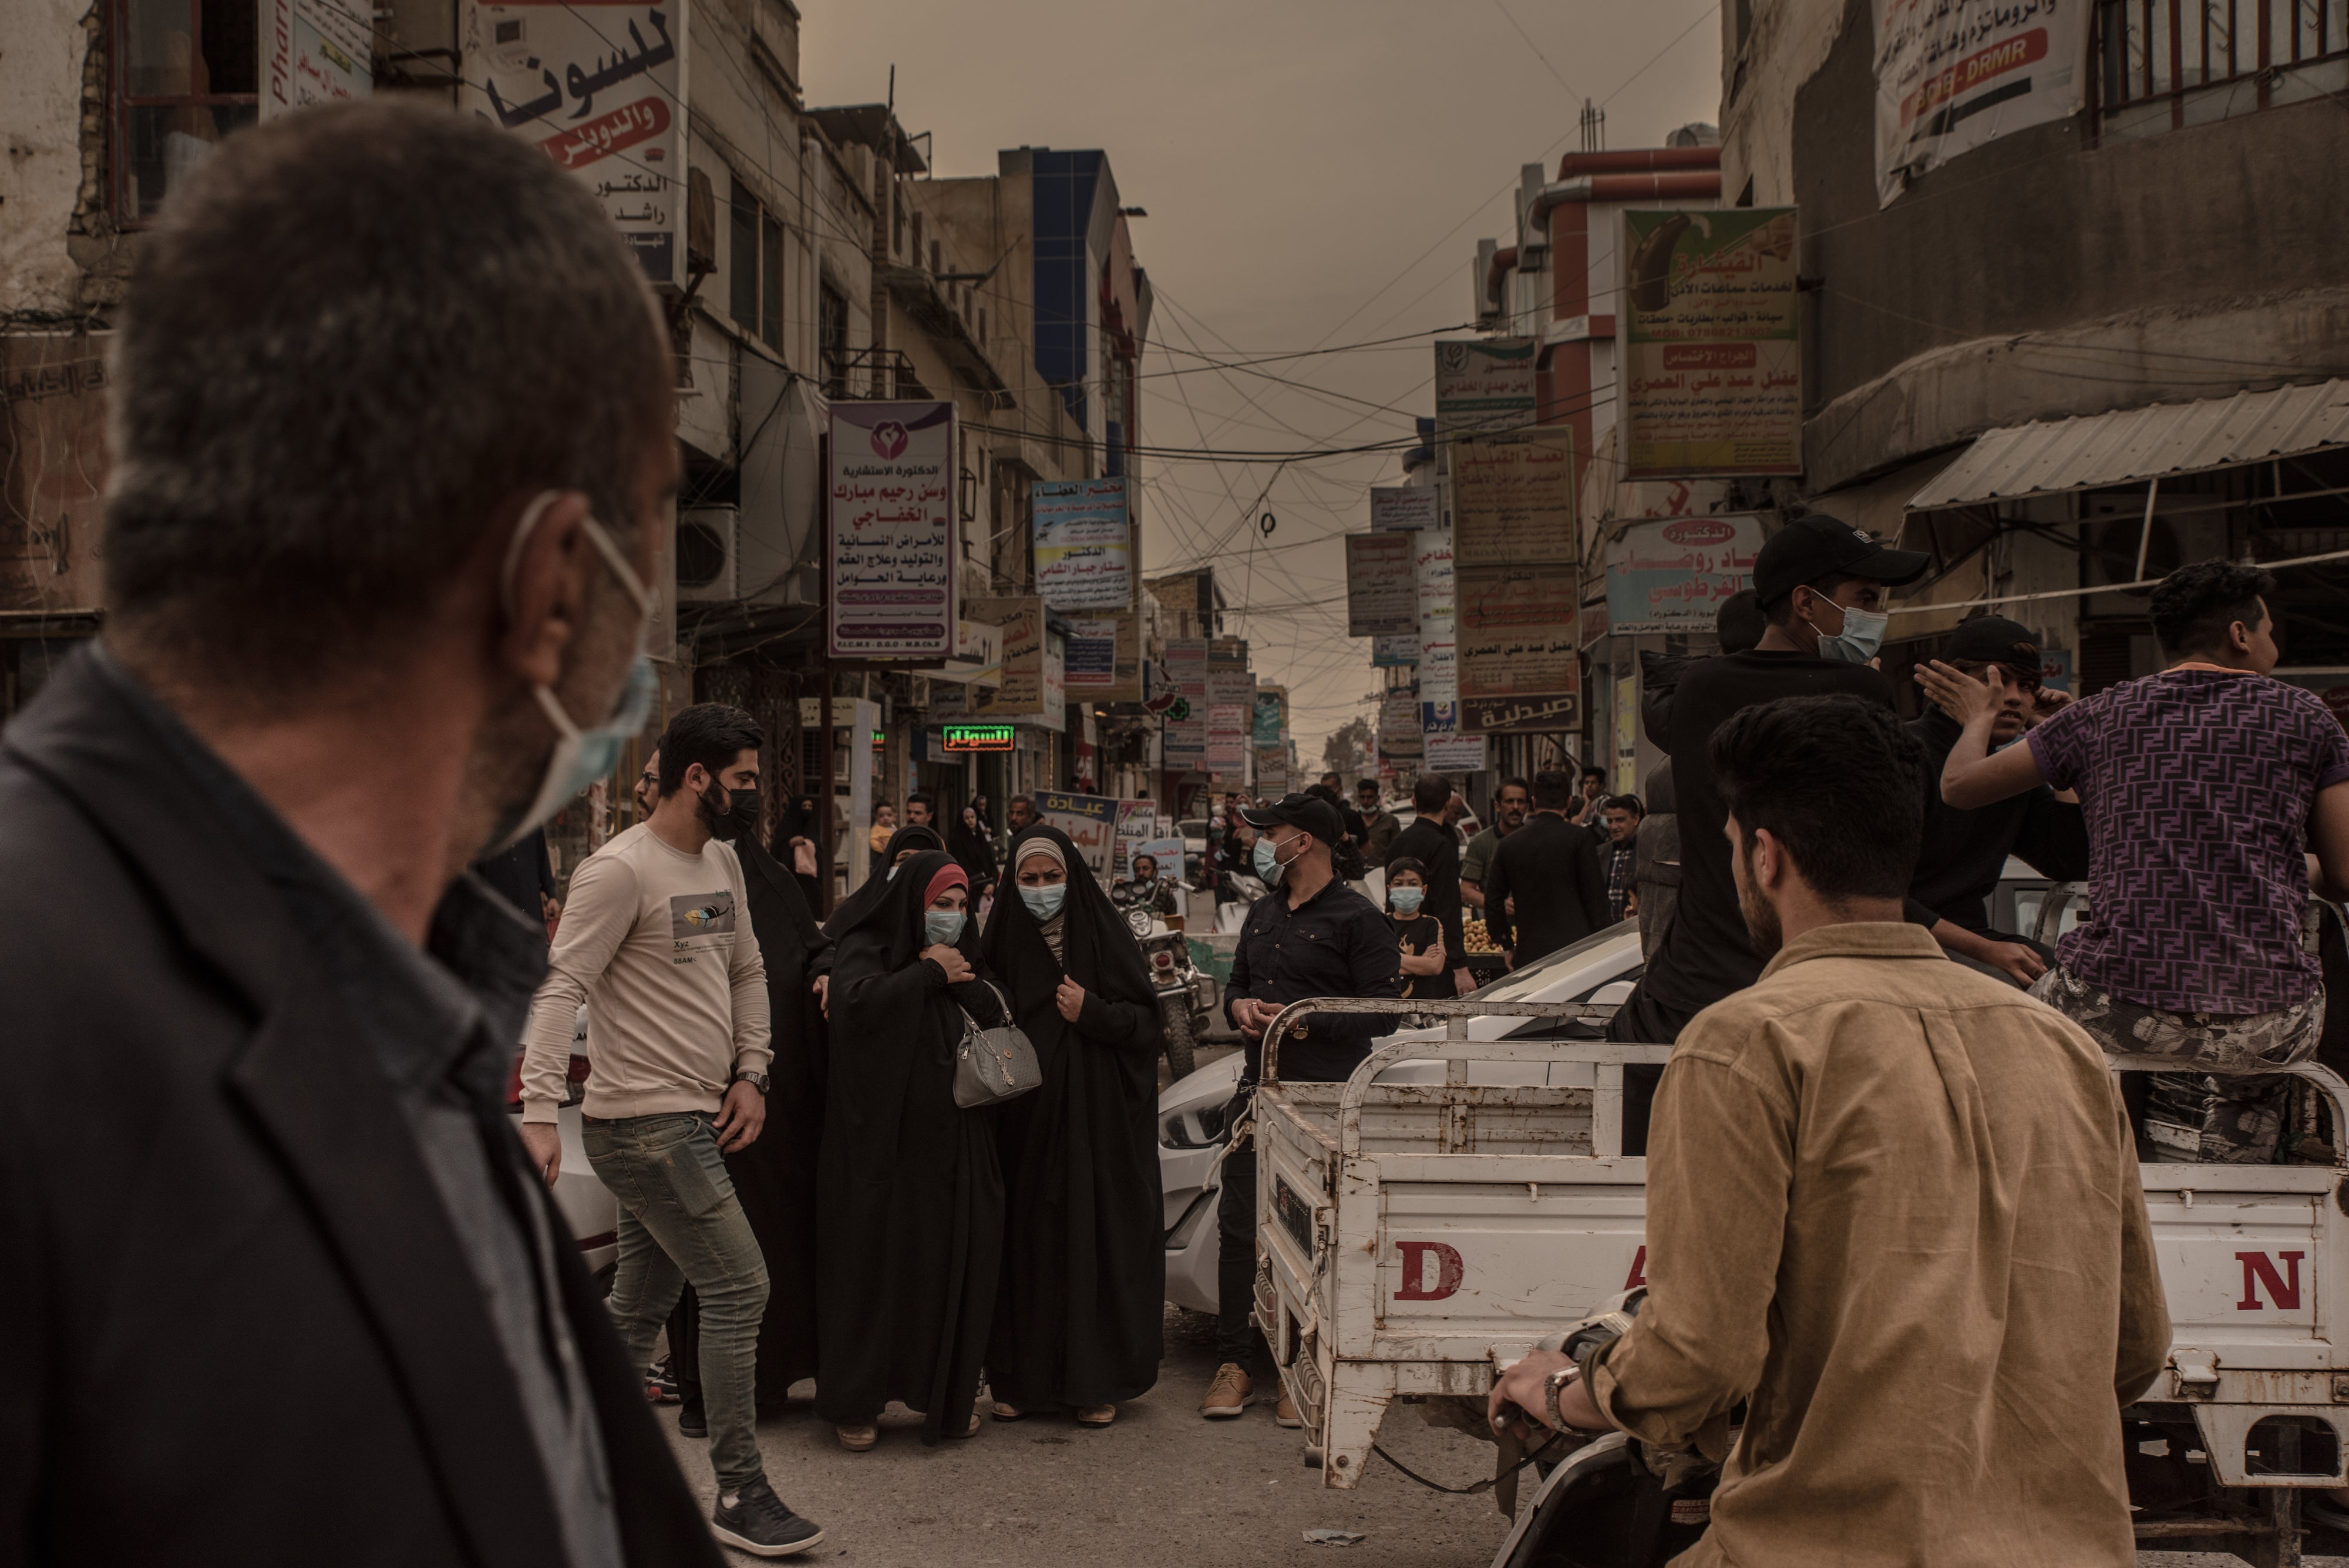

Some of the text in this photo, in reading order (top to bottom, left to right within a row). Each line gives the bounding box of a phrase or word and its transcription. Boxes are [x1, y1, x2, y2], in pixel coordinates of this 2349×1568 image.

[271, 0, 289, 105] Phar
[1967, 38, 2028, 82] DRMR
[474, 7, 675, 129] للسونا
[563, 104, 655, 166] والدوبلر
[593, 173, 668, 197] الدكتور
[615, 201, 665, 225] راشد
[1676, 251, 1761, 278] القيثارة
[1691, 372, 1721, 395] علي
[1727, 374, 1755, 391] عبد
[1759, 371, 1798, 391] عقيل
[843, 465, 938, 478] الدكتورة الاستشارية
[834, 483, 946, 504] وسن رحيم مبارك
[1086, 482, 1123, 499] مختبر
[853, 507, 927, 530] الخفاجي
[1668, 526, 1732, 541] الدكتورة
[837, 553, 863, 567] العقم
[900, 553, 943, 568] والتوليد
[1062, 546, 1106, 560] الدكتور
[1072, 564, 1096, 576] جبار
[1099, 561, 1125, 574] ستار
[1648, 576, 1742, 608] الفرطوسي
[1504, 642, 1523, 658] علي
[1527, 644, 1545, 655] عبد
[1481, 698, 1573, 728] صيدلية
[1046, 795, 1105, 816] عيادة
[674, 941, 689, 949] Xyz
[1395, 1241, 1464, 1301] D
[2235, 1250, 2305, 1310] N
